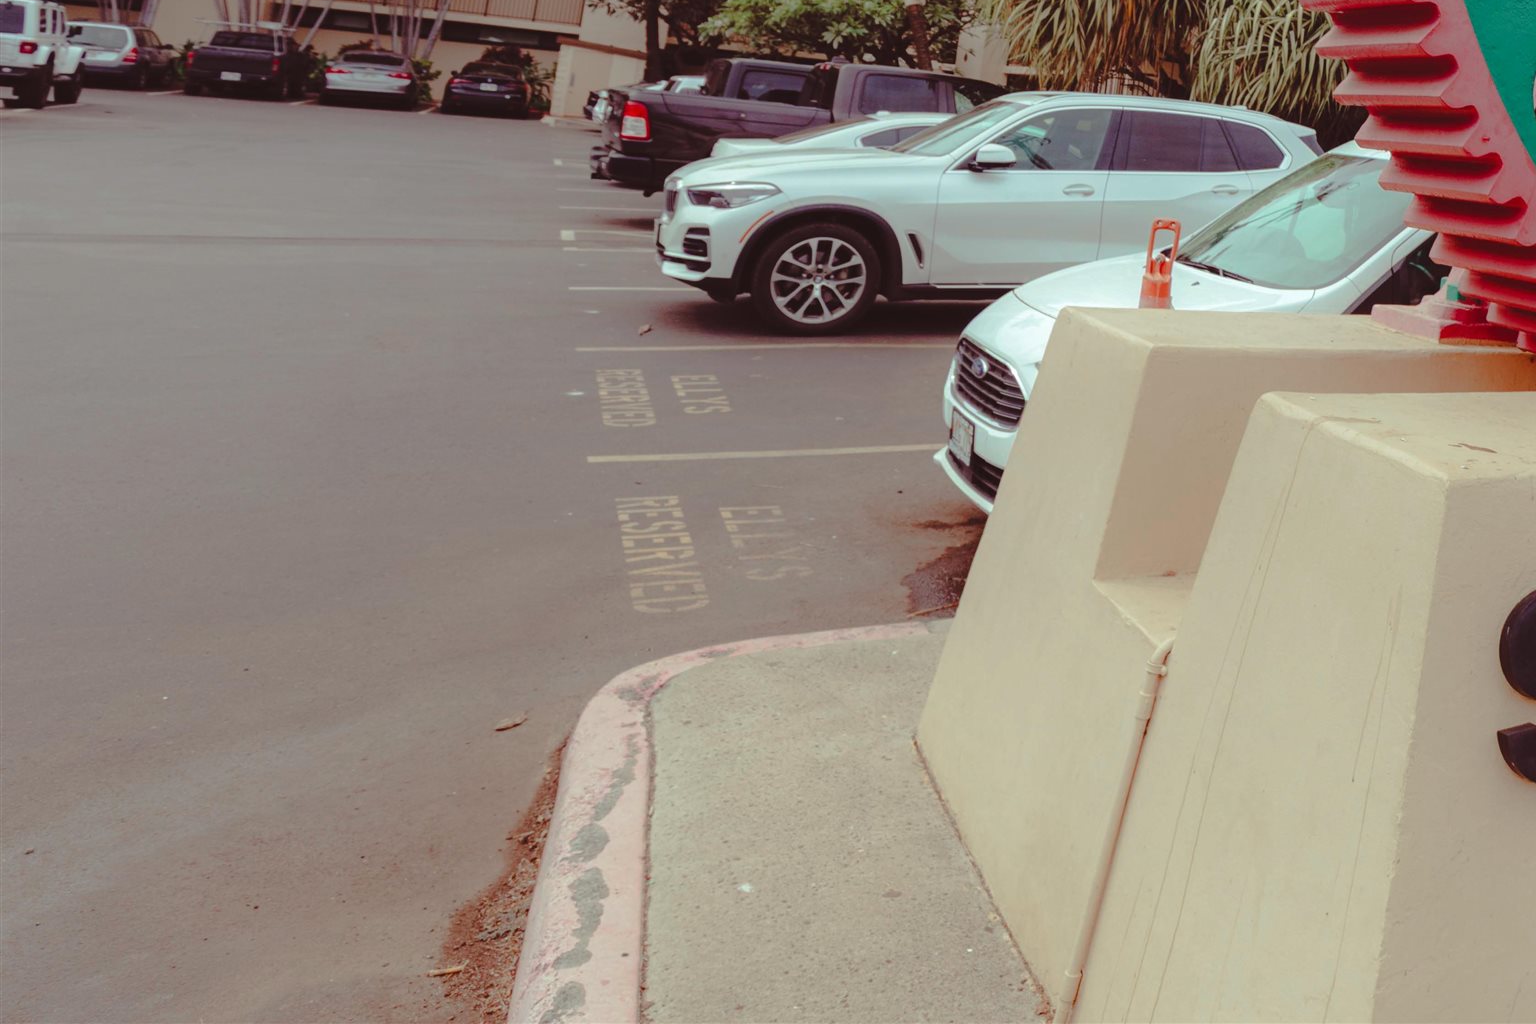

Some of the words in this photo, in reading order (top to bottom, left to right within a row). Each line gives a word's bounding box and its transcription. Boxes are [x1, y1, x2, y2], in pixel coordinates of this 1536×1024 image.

[595, 368, 657, 428] RESERVED
[669, 373, 734, 415] ELLYS
[614, 495, 711, 615] RESERVED
[717, 504, 815, 582] ELLYS
